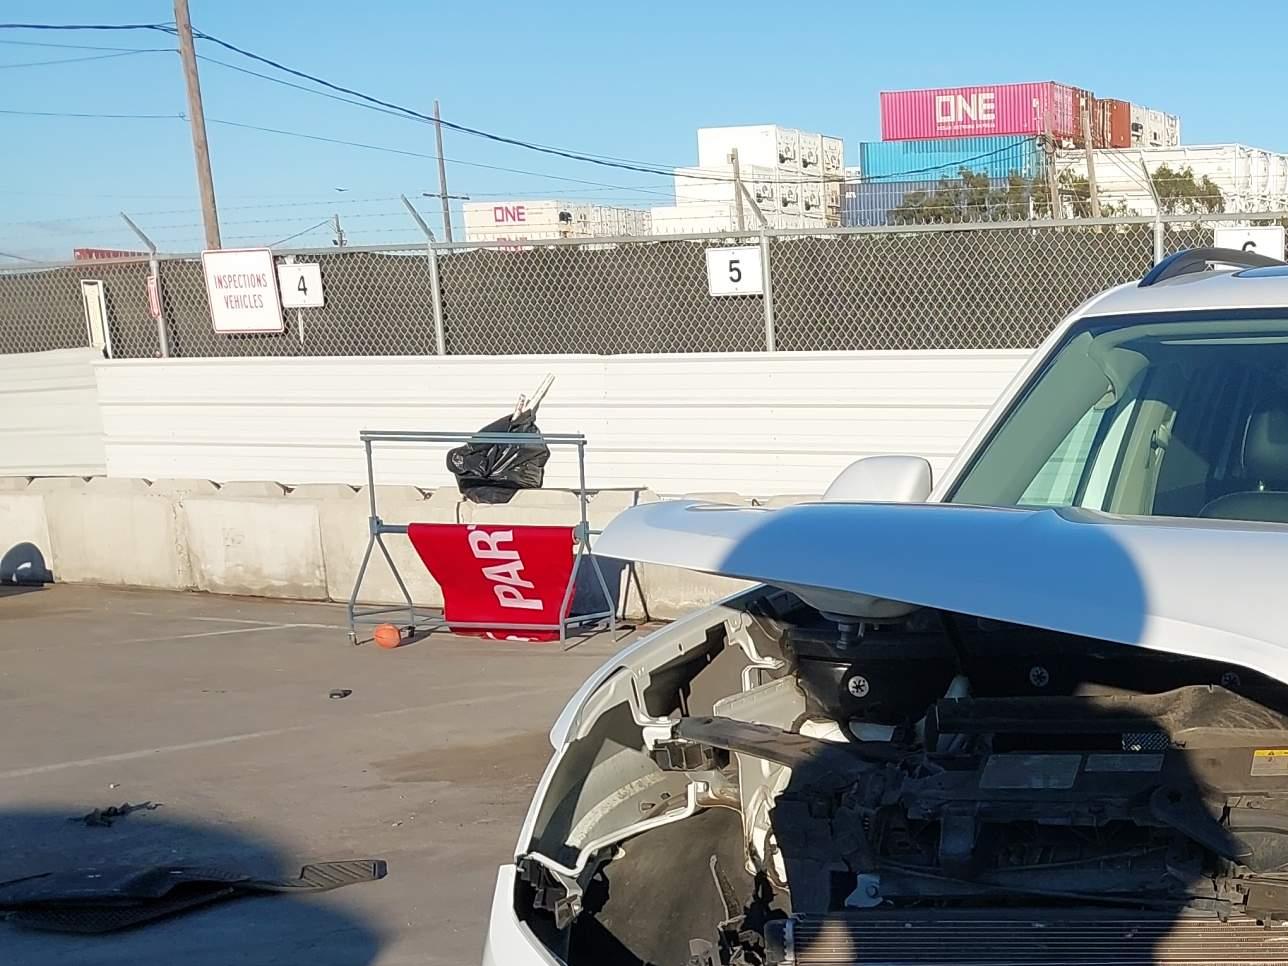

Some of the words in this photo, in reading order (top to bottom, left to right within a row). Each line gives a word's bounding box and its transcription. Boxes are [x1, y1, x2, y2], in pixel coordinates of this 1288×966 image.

[935, 92, 995, 123] ONE
[493, 206, 526, 223] ONE
[213, 273, 268, 289] INSPECTIONS
[729, 260, 742, 283] 5
[297, 275, 308, 296] 4
[223, 294, 264, 309] VEHICLES
[467, 525, 543, 610] PAR
